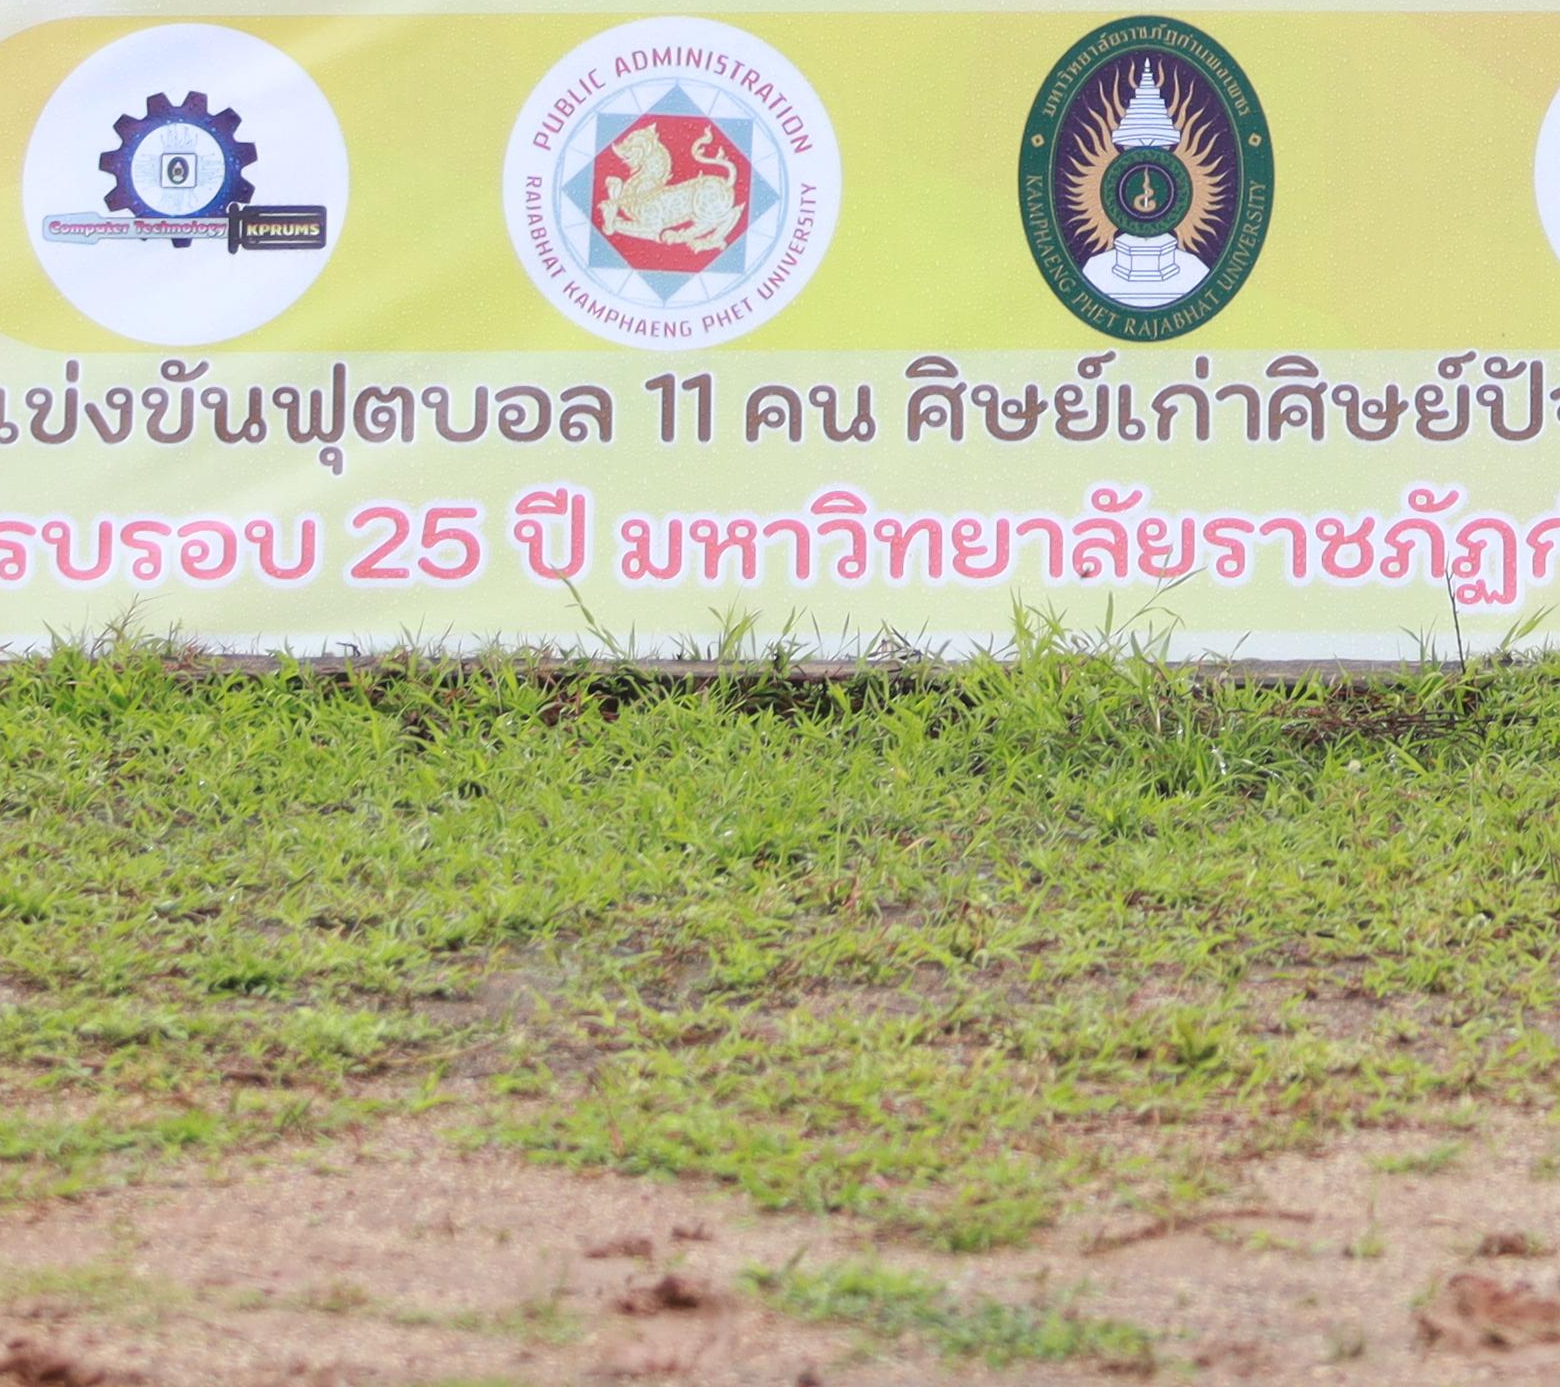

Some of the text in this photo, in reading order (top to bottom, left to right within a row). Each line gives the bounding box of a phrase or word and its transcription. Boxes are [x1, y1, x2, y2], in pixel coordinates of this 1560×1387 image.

[532, 46, 813, 155] PUBLIC ADMINISTRATION
[49, 220, 228, 237] Computer Technology
[246, 223, 321, 236] KPRUMS
[526, 176, 818, 339] RAJABHAT KAMPHAENG PHET UNIVERSITY
[1026, 174, 1267, 340] KAMPHAENG PHET RAJABHAT UNIVERSITY
[645, 373, 714, 443] 11
[746, 381, 873, 443] คน
[348, 507, 482, 581] 25
[512, 487, 589, 582] ปี
